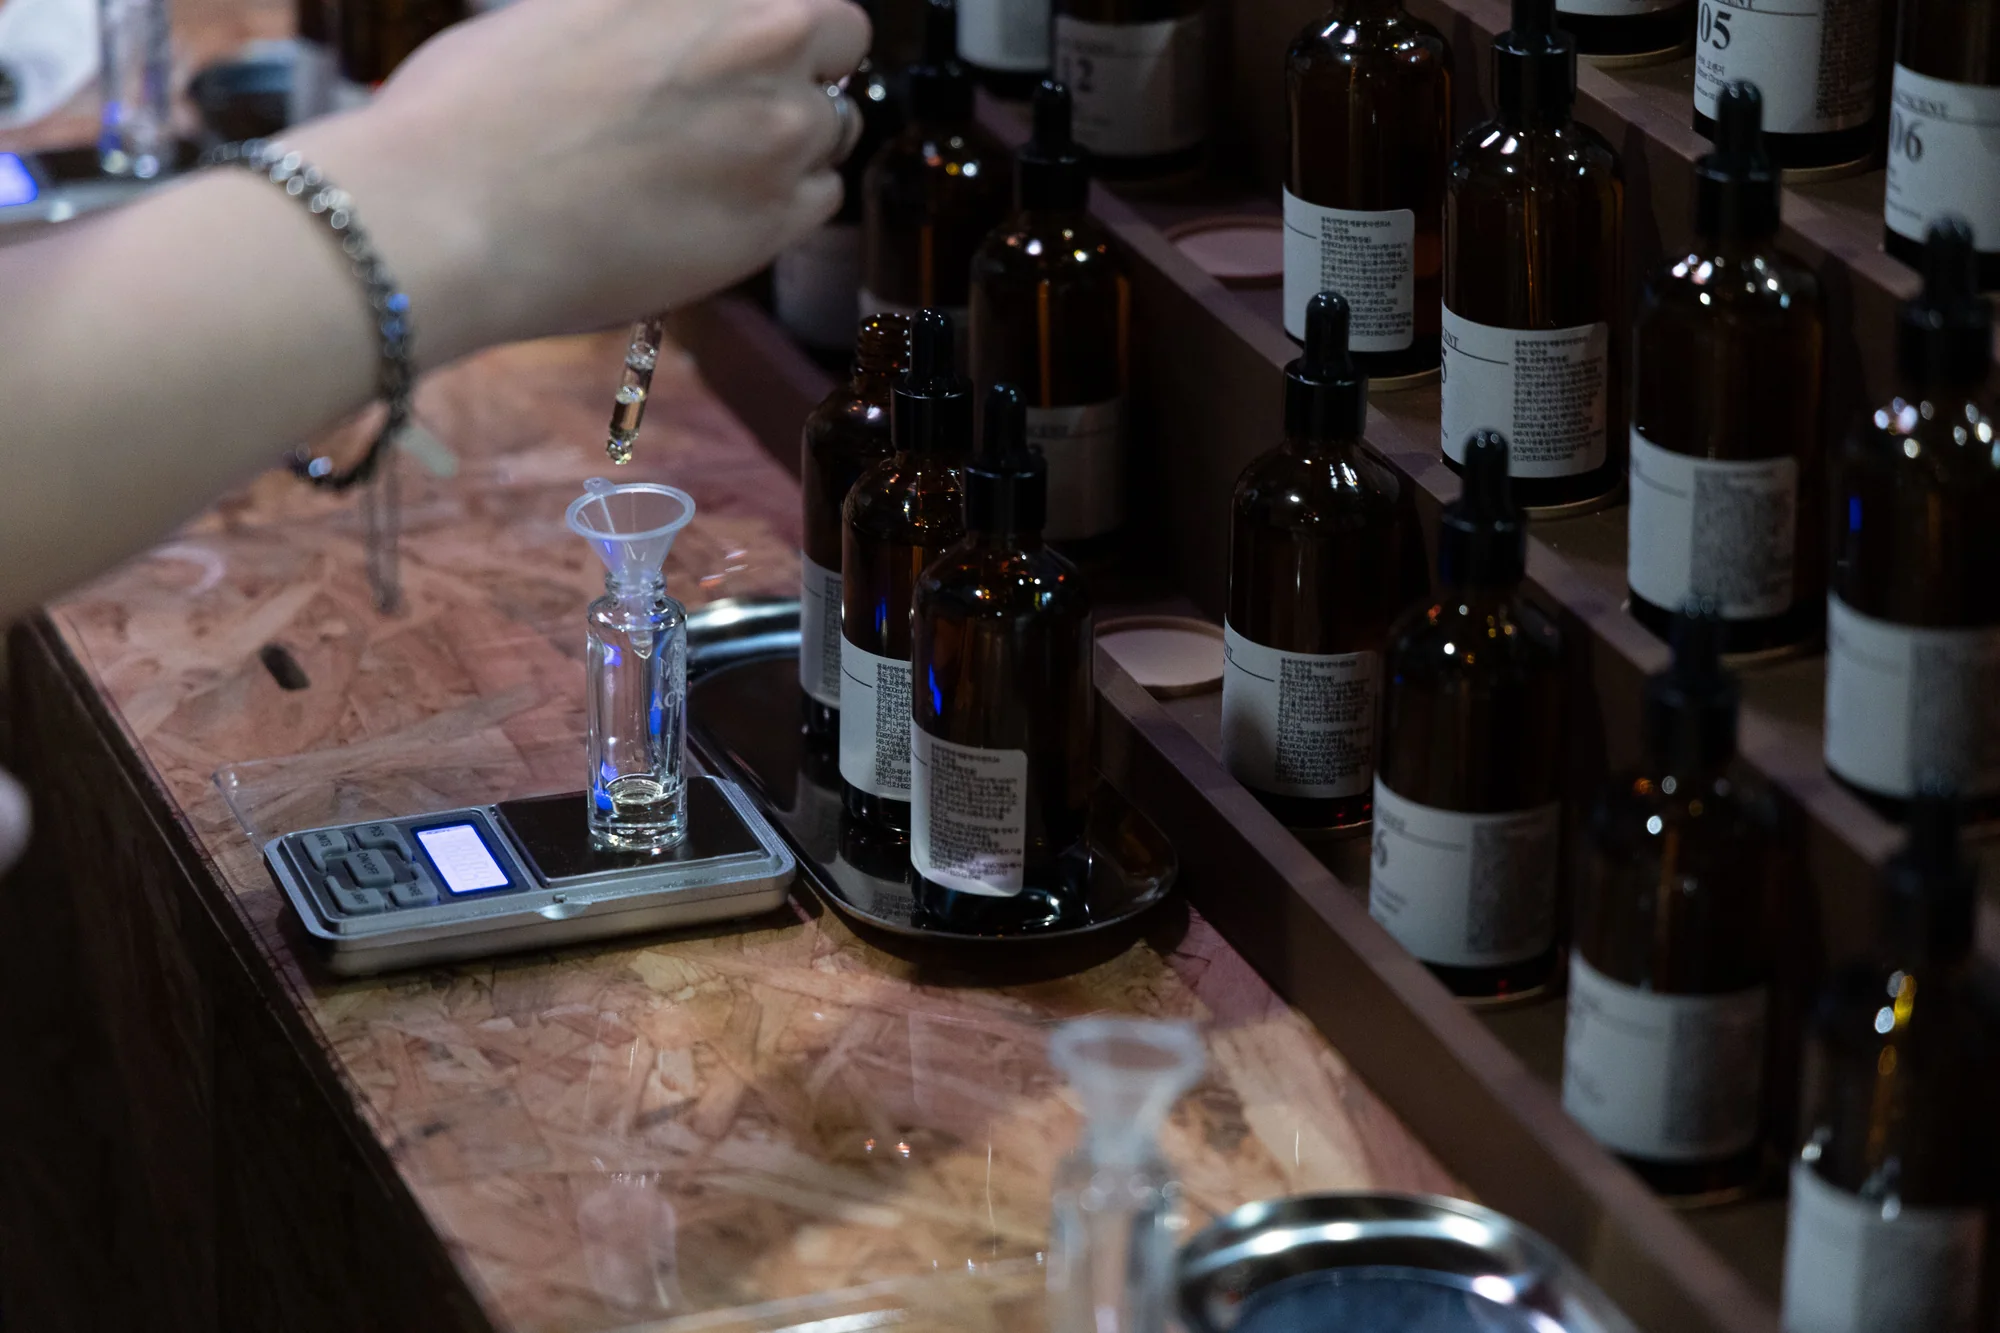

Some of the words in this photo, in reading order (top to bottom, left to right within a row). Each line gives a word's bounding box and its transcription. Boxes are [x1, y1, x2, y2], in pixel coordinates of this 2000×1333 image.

[1700, 2, 1732, 49] 05
[1890, 111, 1924, 163] 06
[314, 832, 333, 847] UNITS
[356, 853, 380, 875] ON/OFF
